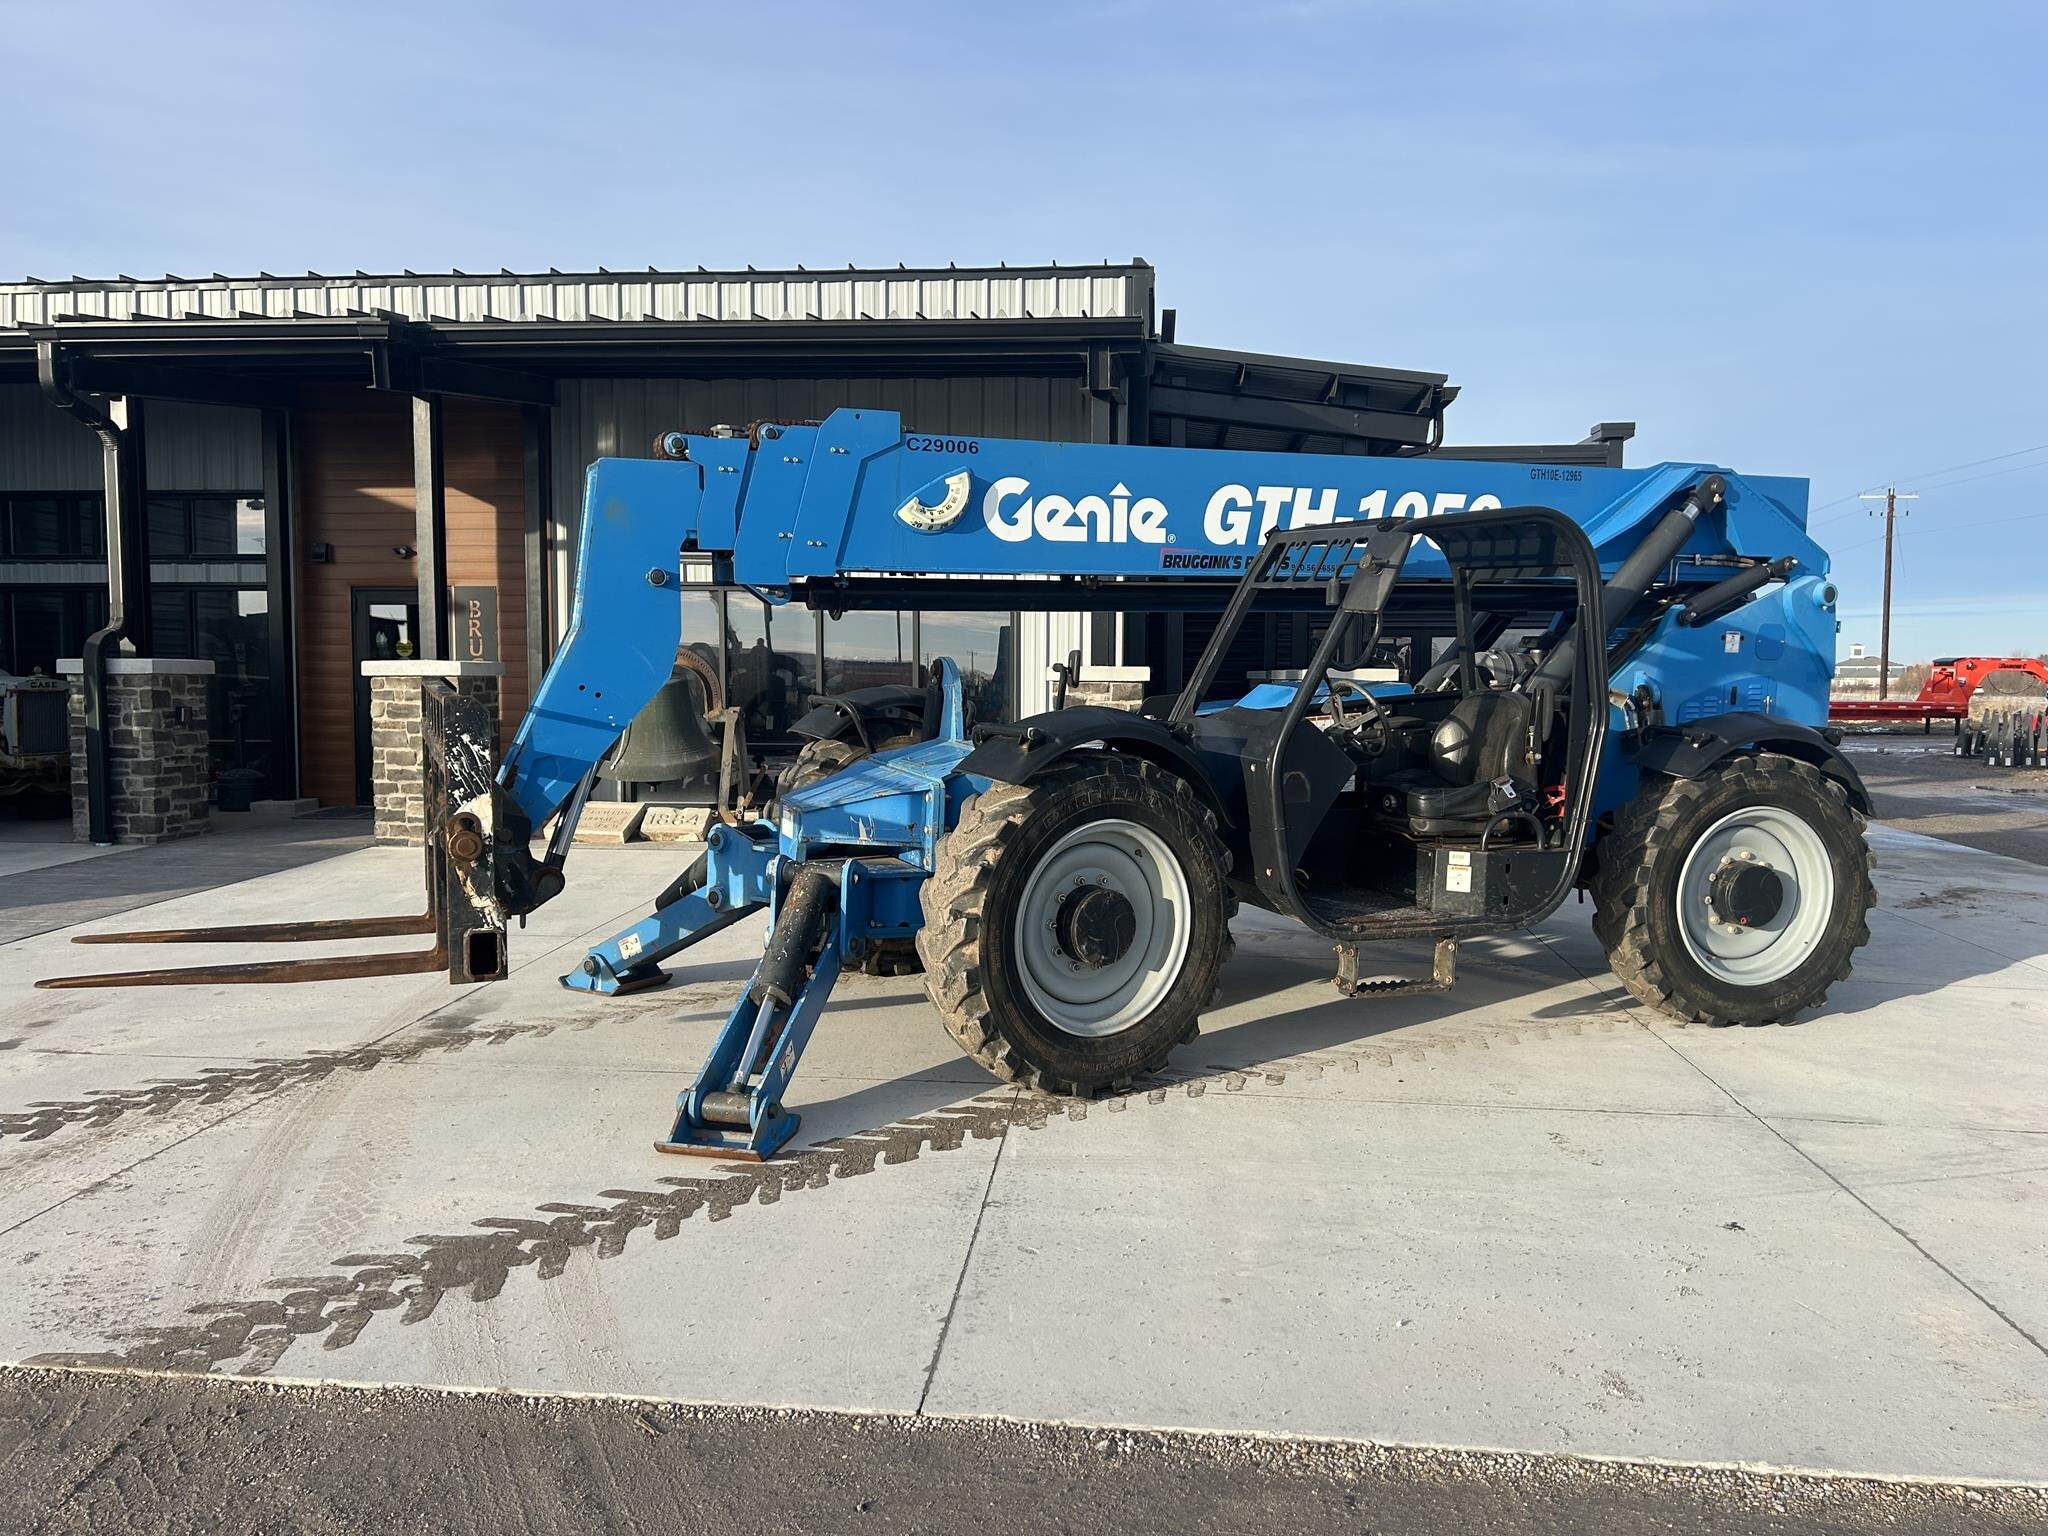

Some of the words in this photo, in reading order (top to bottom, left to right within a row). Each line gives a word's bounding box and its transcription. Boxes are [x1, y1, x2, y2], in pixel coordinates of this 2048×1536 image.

[907, 437, 979, 454] C29006
[1530, 468, 1582, 481] GTH10E-12965
[983, 476, 1169, 543] Genie
[1203, 484, 1502, 551] GTH-10
[1162, 554, 1243, 570] BRUGGINK'S
[468, 599, 484, 661] BRU
[649, 812, 699, 826] 1884
